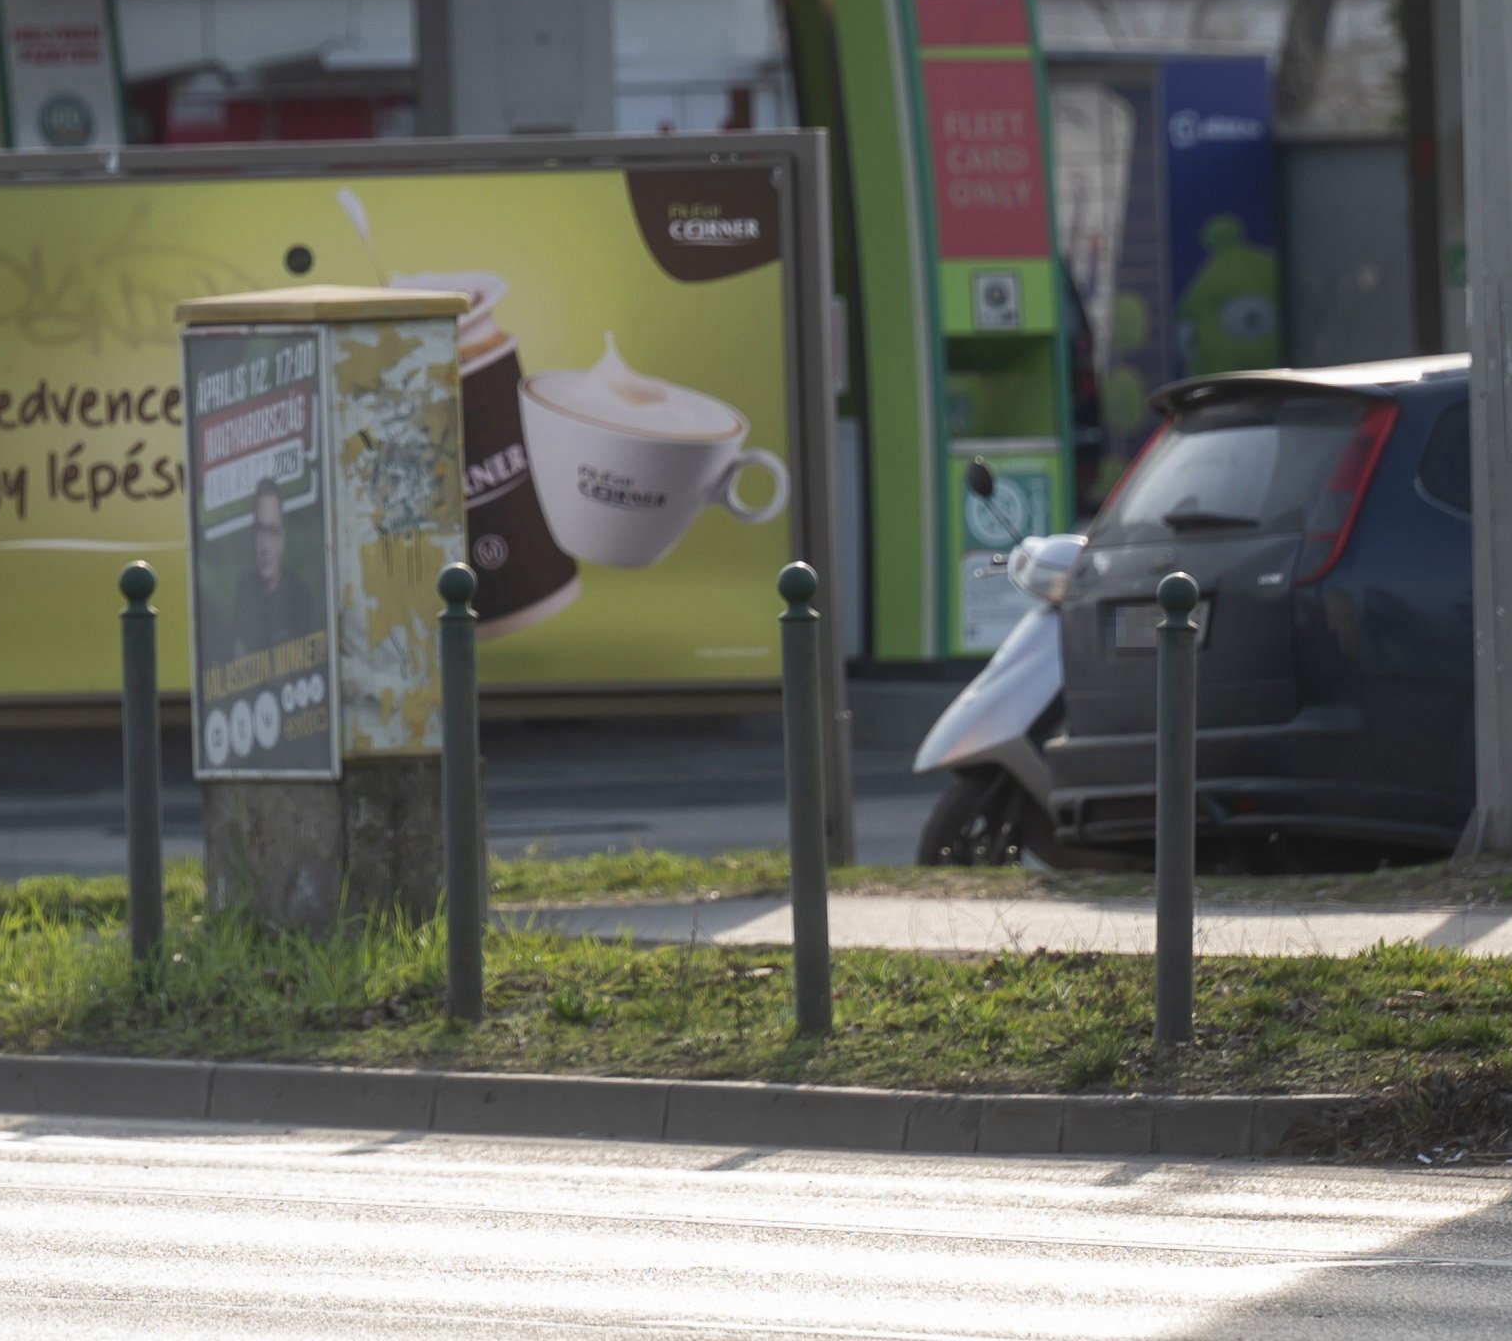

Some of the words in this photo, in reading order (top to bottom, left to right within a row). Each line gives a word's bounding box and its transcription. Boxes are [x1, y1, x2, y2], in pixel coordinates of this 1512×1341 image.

[943, 111, 1026, 141] FLEET
[944, 143, 1031, 175] CARD
[948, 179, 1033, 209] ONLY
[48, 440, 184, 512] lépés
